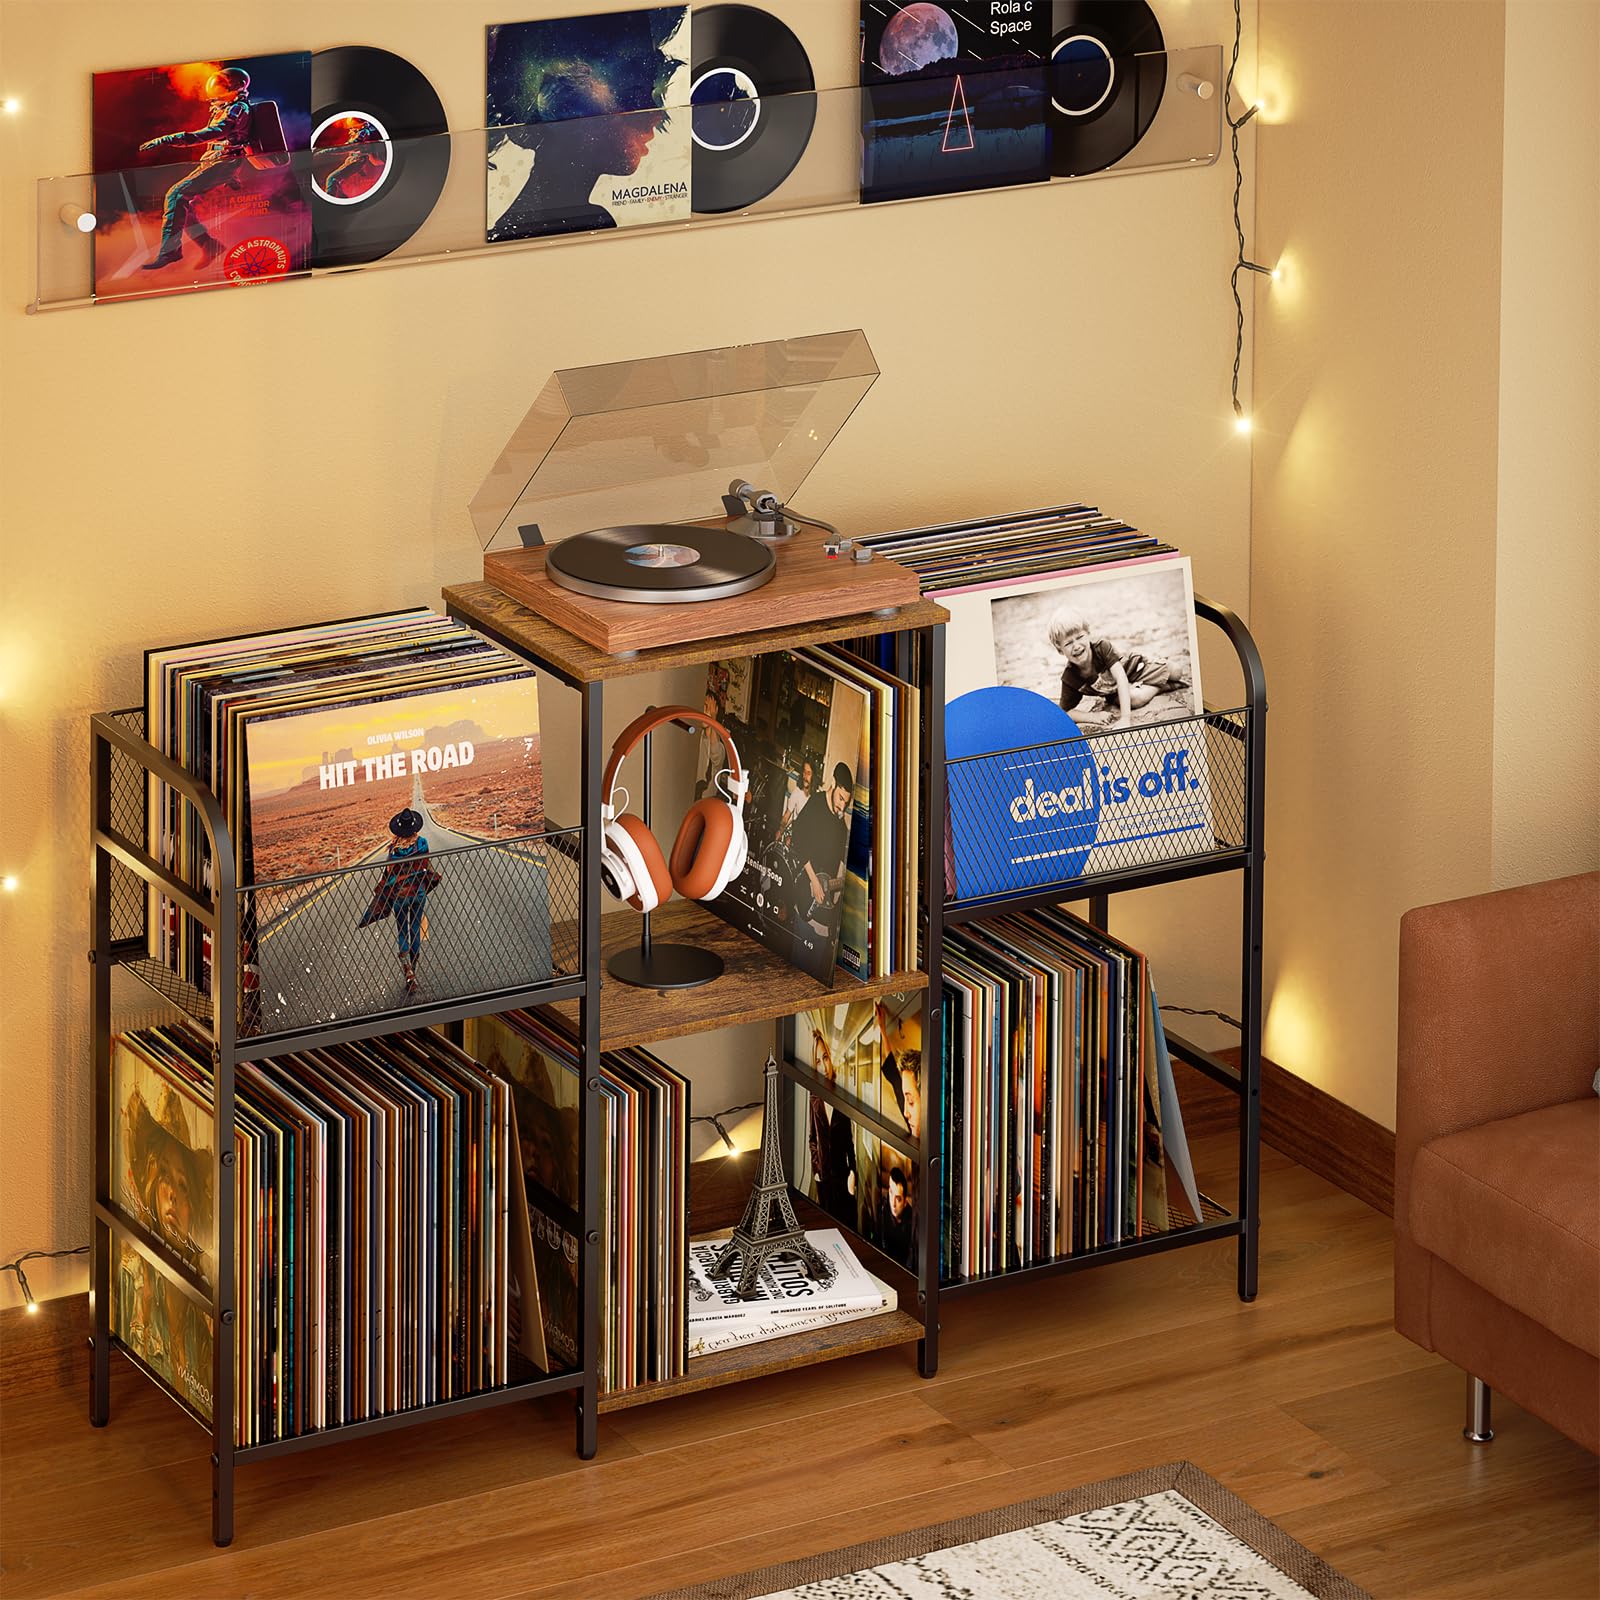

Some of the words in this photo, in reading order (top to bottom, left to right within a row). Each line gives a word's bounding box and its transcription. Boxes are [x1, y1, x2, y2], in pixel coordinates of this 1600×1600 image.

[990, 0, 1020, 15] Rola
[1024, 1, 1033, 12] c
[990, 20, 1032, 37] Space
[611, 181, 688, 201] MAGDALENA
[230, 245, 247, 258] THE
[247, 239, 287, 269] ASTRONAUTS
[367, 732, 393, 745] OLIVIA
[393, 727, 425, 741] WILSON
[319, 760, 357, 790] HIT
[361, 751, 407, 782] THE
[411, 740, 475, 774] ROAD
[1009, 767, 1094, 824] deal
[1102, 765, 1130, 806] is
[1138, 749, 1200, 798] off.
[767, 867, 783, 887] Song
